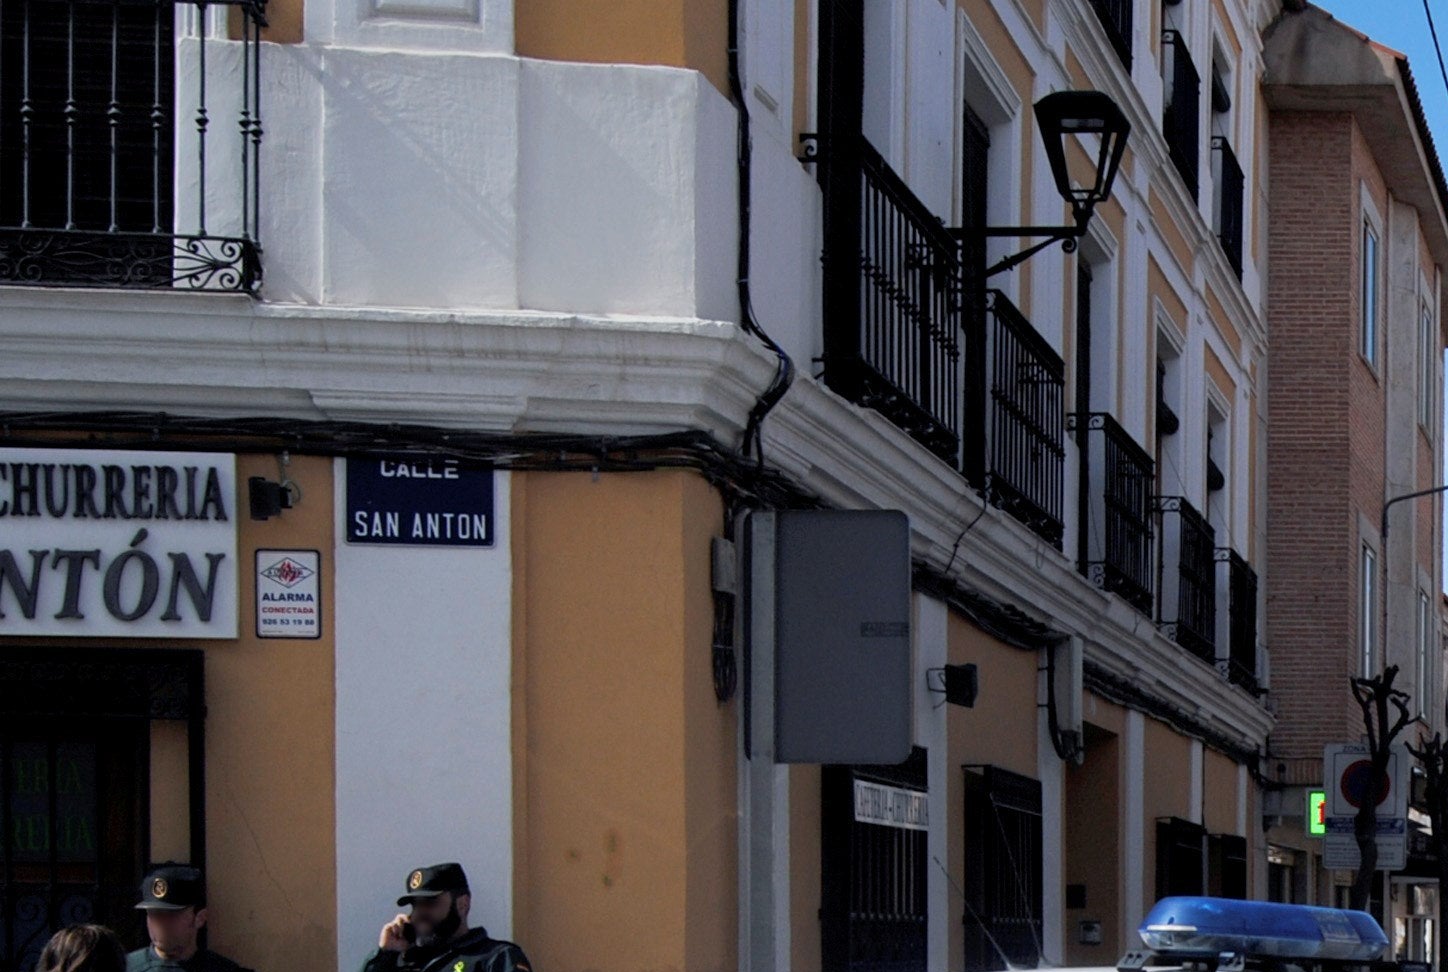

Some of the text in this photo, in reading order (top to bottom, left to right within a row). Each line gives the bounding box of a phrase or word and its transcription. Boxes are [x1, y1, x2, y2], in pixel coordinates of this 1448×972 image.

[381, 460, 460, 479] CALLE
[354, 510, 487, 540] SAN ANTON
[262, 593, 314, 603] ALARMA
[262, 607, 314, 615] CONECTADA
[1342, 745, 1367, 754] ZONA
